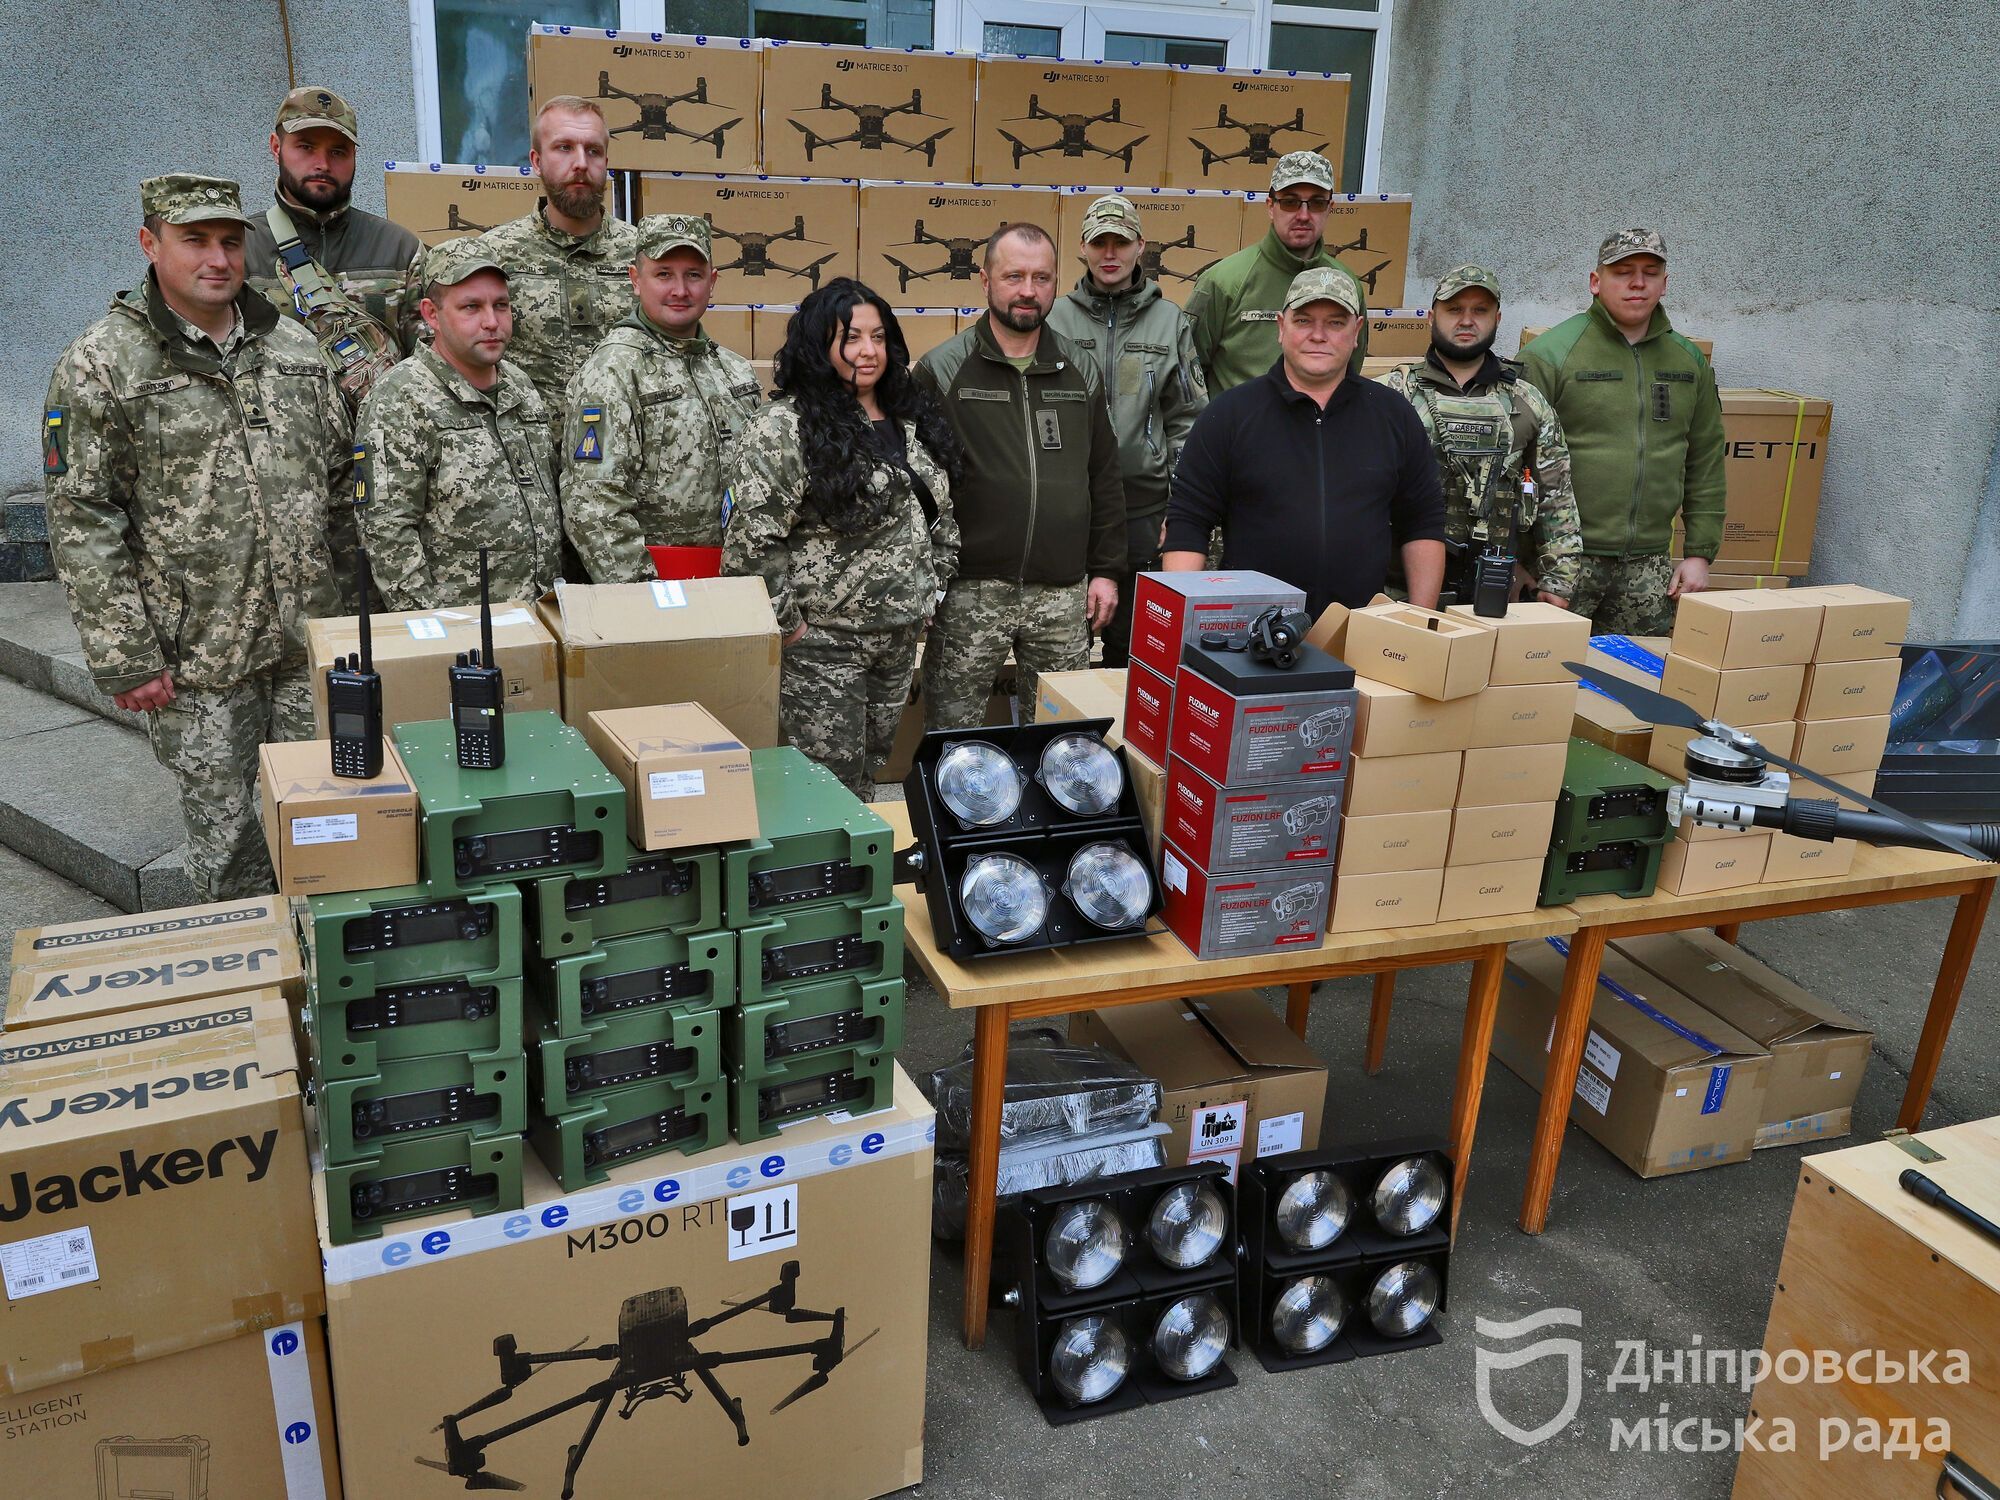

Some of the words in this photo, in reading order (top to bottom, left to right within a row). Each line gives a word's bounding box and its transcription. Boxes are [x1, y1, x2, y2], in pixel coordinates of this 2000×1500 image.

[634, 49, 671, 59] MATRICE
[856, 63, 890, 72] MATRICE
[892, 64, 902, 72] 30
[1062, 74, 1093, 82] MATRICE
[1095, 74, 1104, 82] 30
[1250, 84, 1278, 92] MATRICE
[483, 182, 520, 190] MATRICE
[737, 190, 772, 199] MATRICE
[774, 191, 784, 199] 30
[948, 199, 979, 207] MATRICE
[1455, 424, 1484, 434] CASPER
[1146, 600, 1163, 616] FUZION
[1163, 609, 1172, 619] LRF
[1137, 687, 1151, 702] FUZION
[1188, 696, 1208, 712] FUZION
[1208, 705, 1219, 718] LRF
[1892, 699, 1913, 718] 12:00
[1249, 725, 1279, 734] FUZION
[1282, 724, 1297, 732] LRF
[1177, 782, 1194, 800] FUZION
[1194, 794, 1203, 807] LRF
[1231, 814, 1262, 823] FUZION
[1265, 812, 1281, 821] LRF
[1221, 901, 1252, 910] FUZION
[1254, 900, 1270, 908] LRF
[187, 908, 259, 927] SOLAR
[44, 920, 182, 946] GENERATOR
[33, 948, 278, 1001] Jackery
[168, 1010, 249, 1033] SOLAR
[2, 1028, 161, 1060] GENERATOR
[0, 1062, 259, 1130] Jackery
[1201, 1138, 1213, 1146] UN
[1216, 1135, 1233, 1144] 3091
[0, 1129, 278, 1222] Jackery
[567, 1213, 669, 1258] M300
[6, 1410, 87, 1439] STATION
